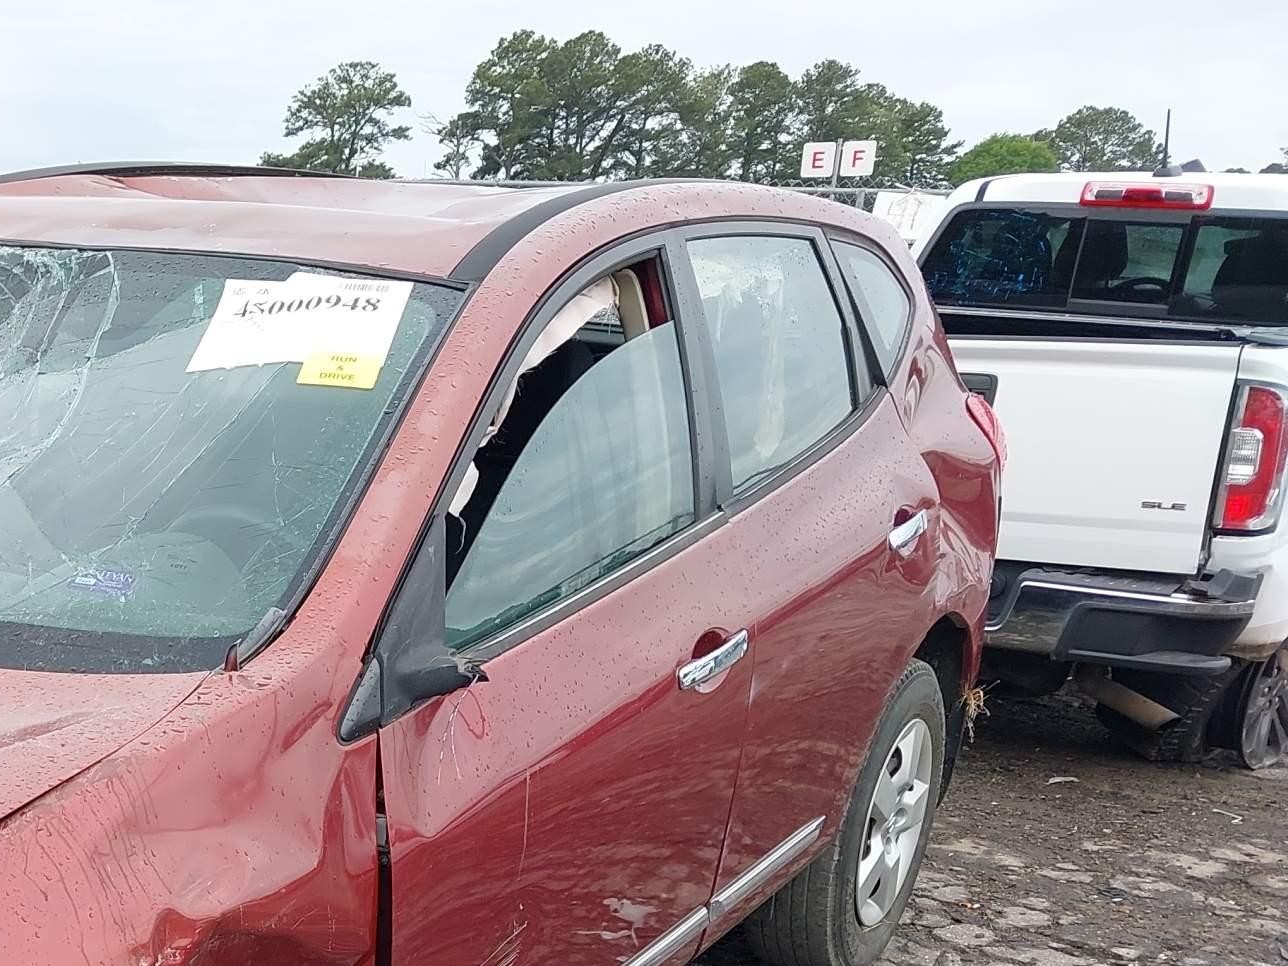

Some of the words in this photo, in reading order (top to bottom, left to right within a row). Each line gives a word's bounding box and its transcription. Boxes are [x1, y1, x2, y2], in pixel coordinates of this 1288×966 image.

[811, 151, 825, 169] E
[851, 150, 866, 168] F
[233, 294, 381, 318] 45000948
[330, 355, 358, 363] RUN
[319, 372, 358, 381] DRIVE
[1141, 501, 1187, 511] SLE
